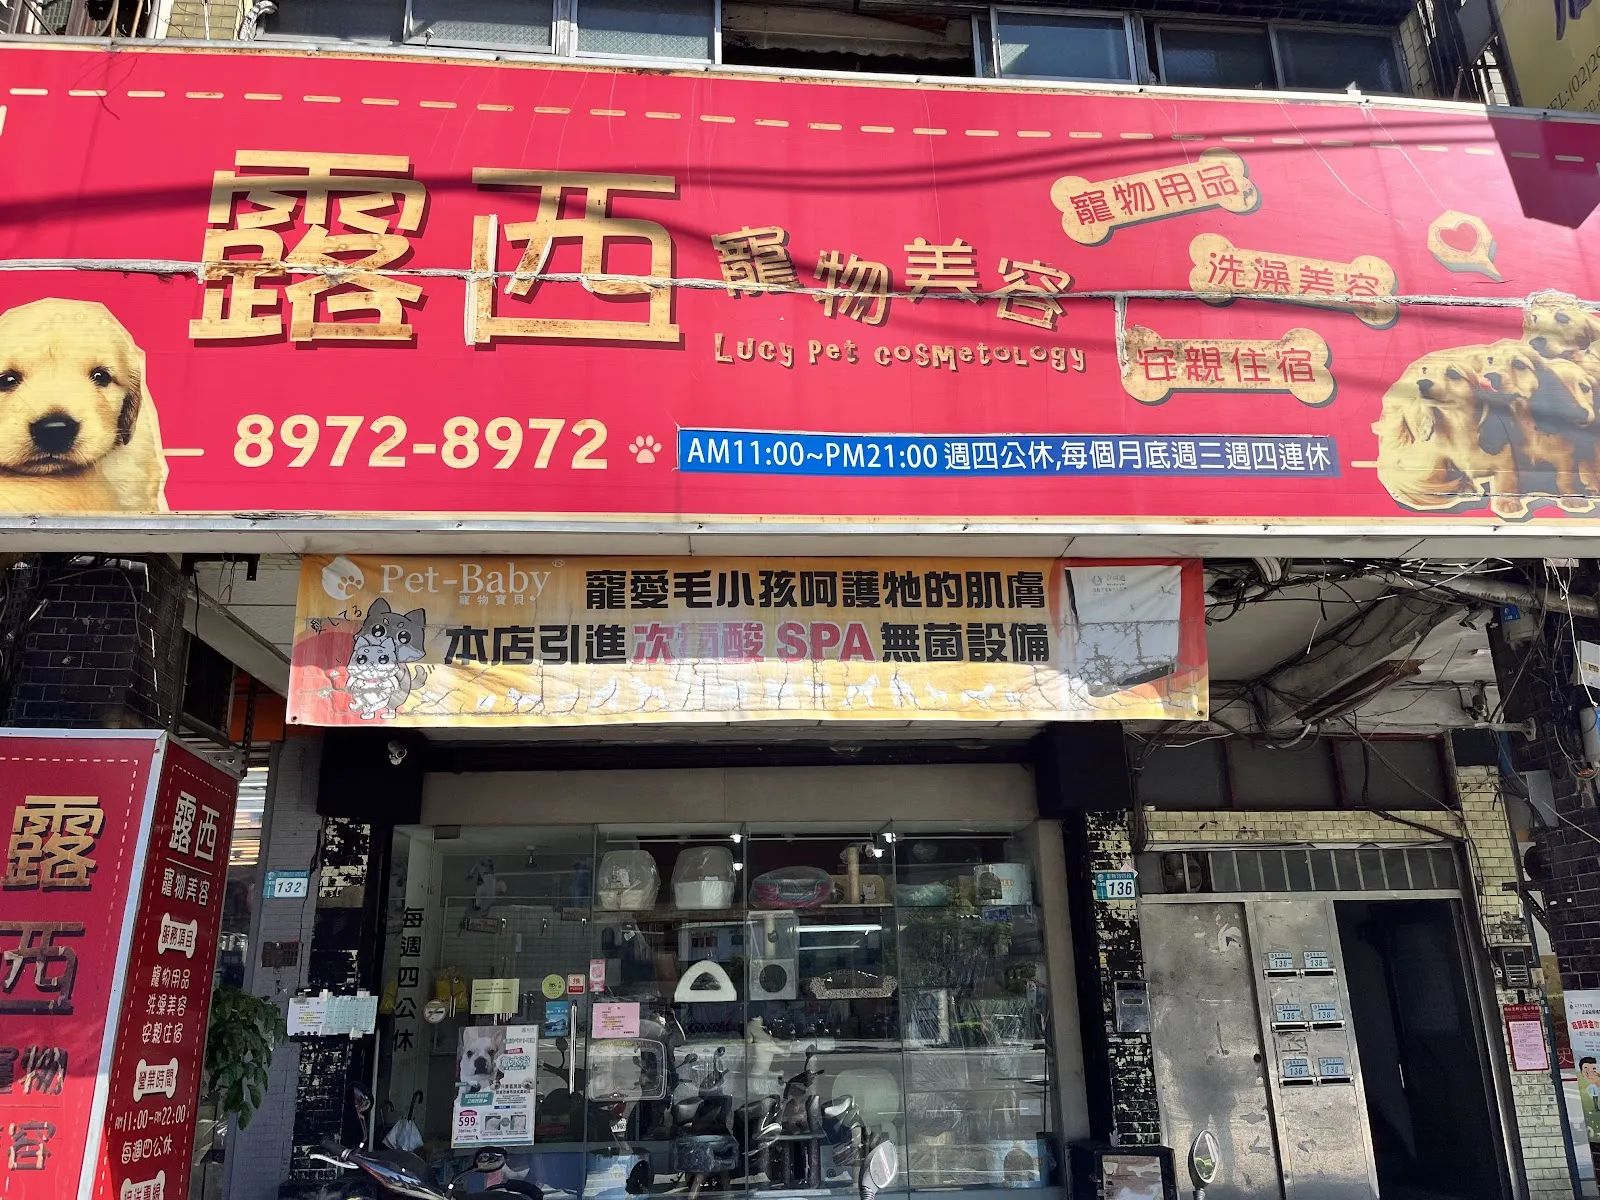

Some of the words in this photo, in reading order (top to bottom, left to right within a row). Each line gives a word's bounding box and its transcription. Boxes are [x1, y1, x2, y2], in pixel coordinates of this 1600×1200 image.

[1069, 163, 1241, 227] 寵物用品
[189, 149, 682, 346] 露西
[711, 225, 1071, 331] 寵物美容
[1207, 250, 1382, 314] 洗澡美容
[714, 332, 793, 368] Lucy
[808, 338, 857, 365] Pet
[1137, 346, 1317, 384] 安親住宿
[233, 414, 609, 471] 8972-8972
[687, 437, 938, 469] AM11:00~PM21:00
[380, 562, 551, 600] Pet-Baby
[585, 569, 1046, 611] 寵愛毛小孩呵護牠的肌膚
[776, 621, 876, 664] SPA
[880, 622, 1050, 663] 無菌設備
[169, 790, 220, 862] 露西
[0, 795, 104, 1014] 露西
[161, 866, 210, 906] 寵物美容
[276, 881, 302, 893] 132
[1108, 881, 1133, 896] 136
[162, 924, 194, 948] 服務項目
[150, 964, 191, 990] 寵物用品
[392, 906, 424, 1052] 每週四公休
[146, 993, 187, 1017] 洗澡美容
[141, 1021, 184, 1044] 安親住宿
[138, 1068, 175, 1091] 營業時間
[1289, 1067, 1303, 1076] 136
[458, 1116, 477, 1127] 599
[121, 1133, 173, 1165] 每週四公休
